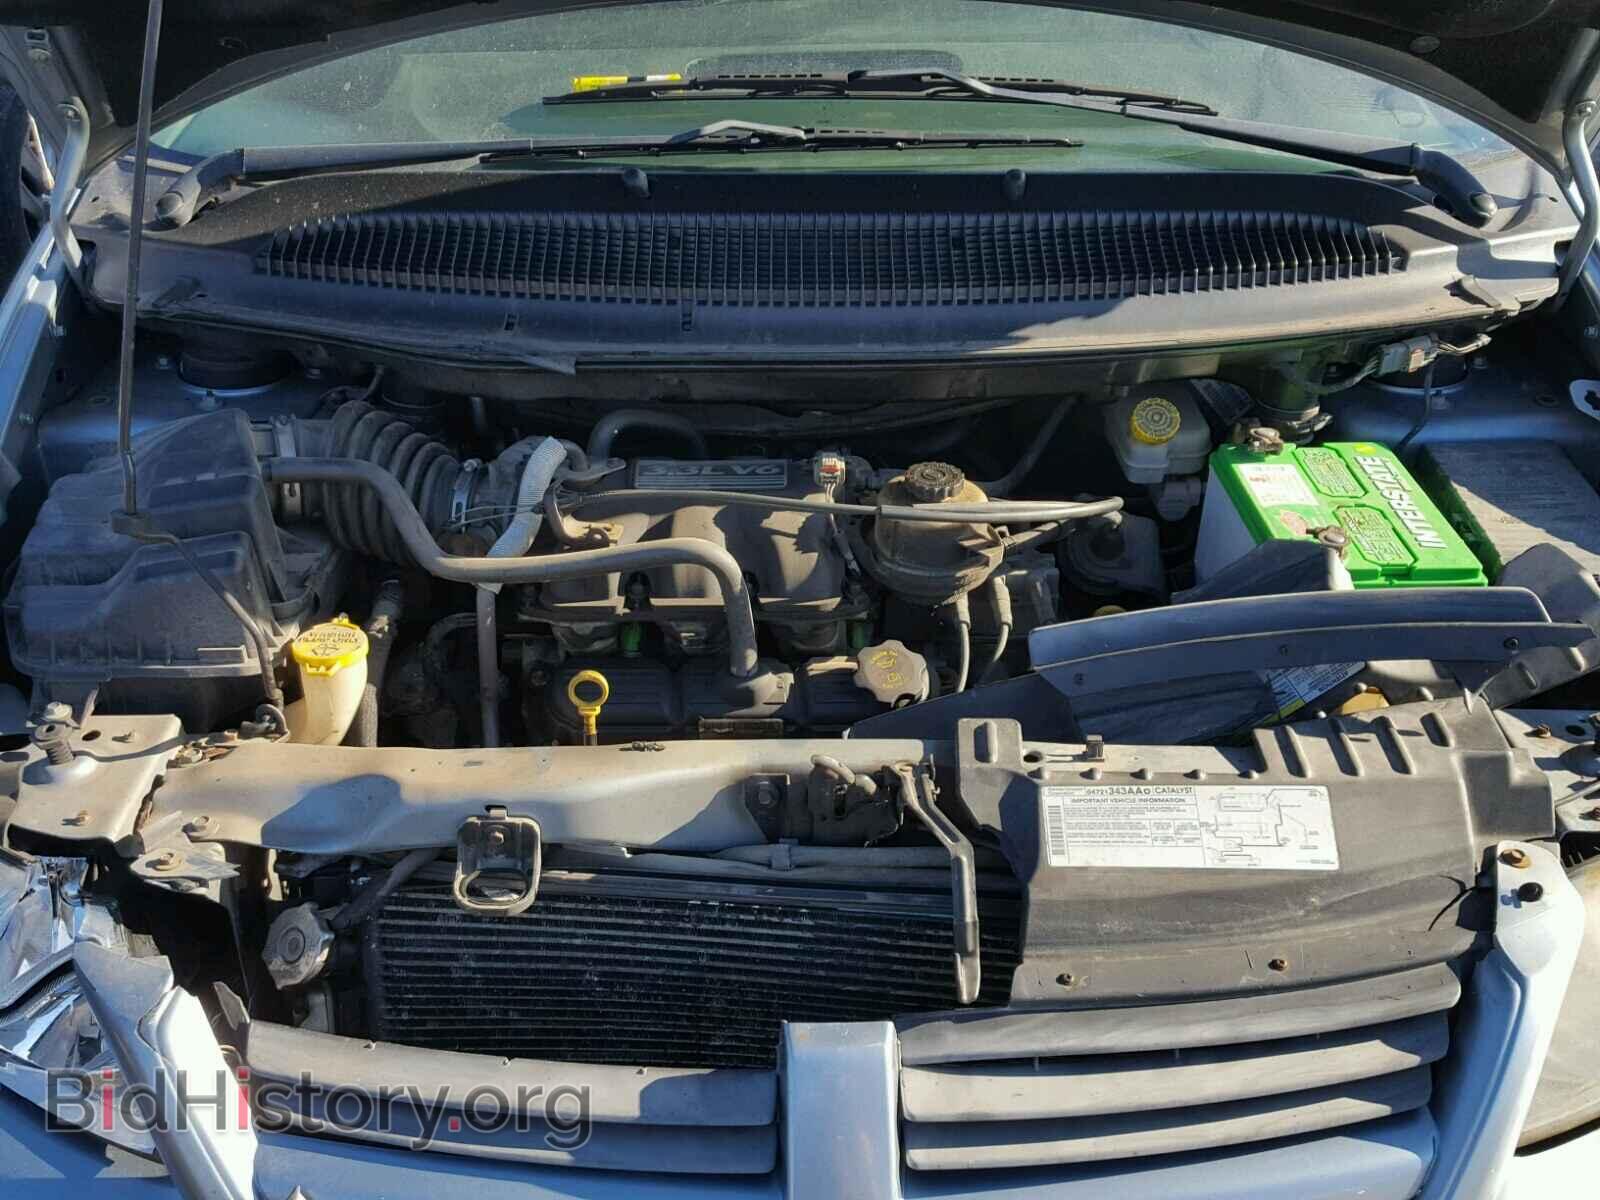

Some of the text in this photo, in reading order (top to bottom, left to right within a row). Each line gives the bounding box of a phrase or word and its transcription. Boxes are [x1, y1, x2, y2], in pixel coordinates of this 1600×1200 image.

[642, 463, 781, 477] 3.3L V6
[1354, 456, 1447, 549] INTERSTATE
[1154, 786, 1193, 794] CATALYST
